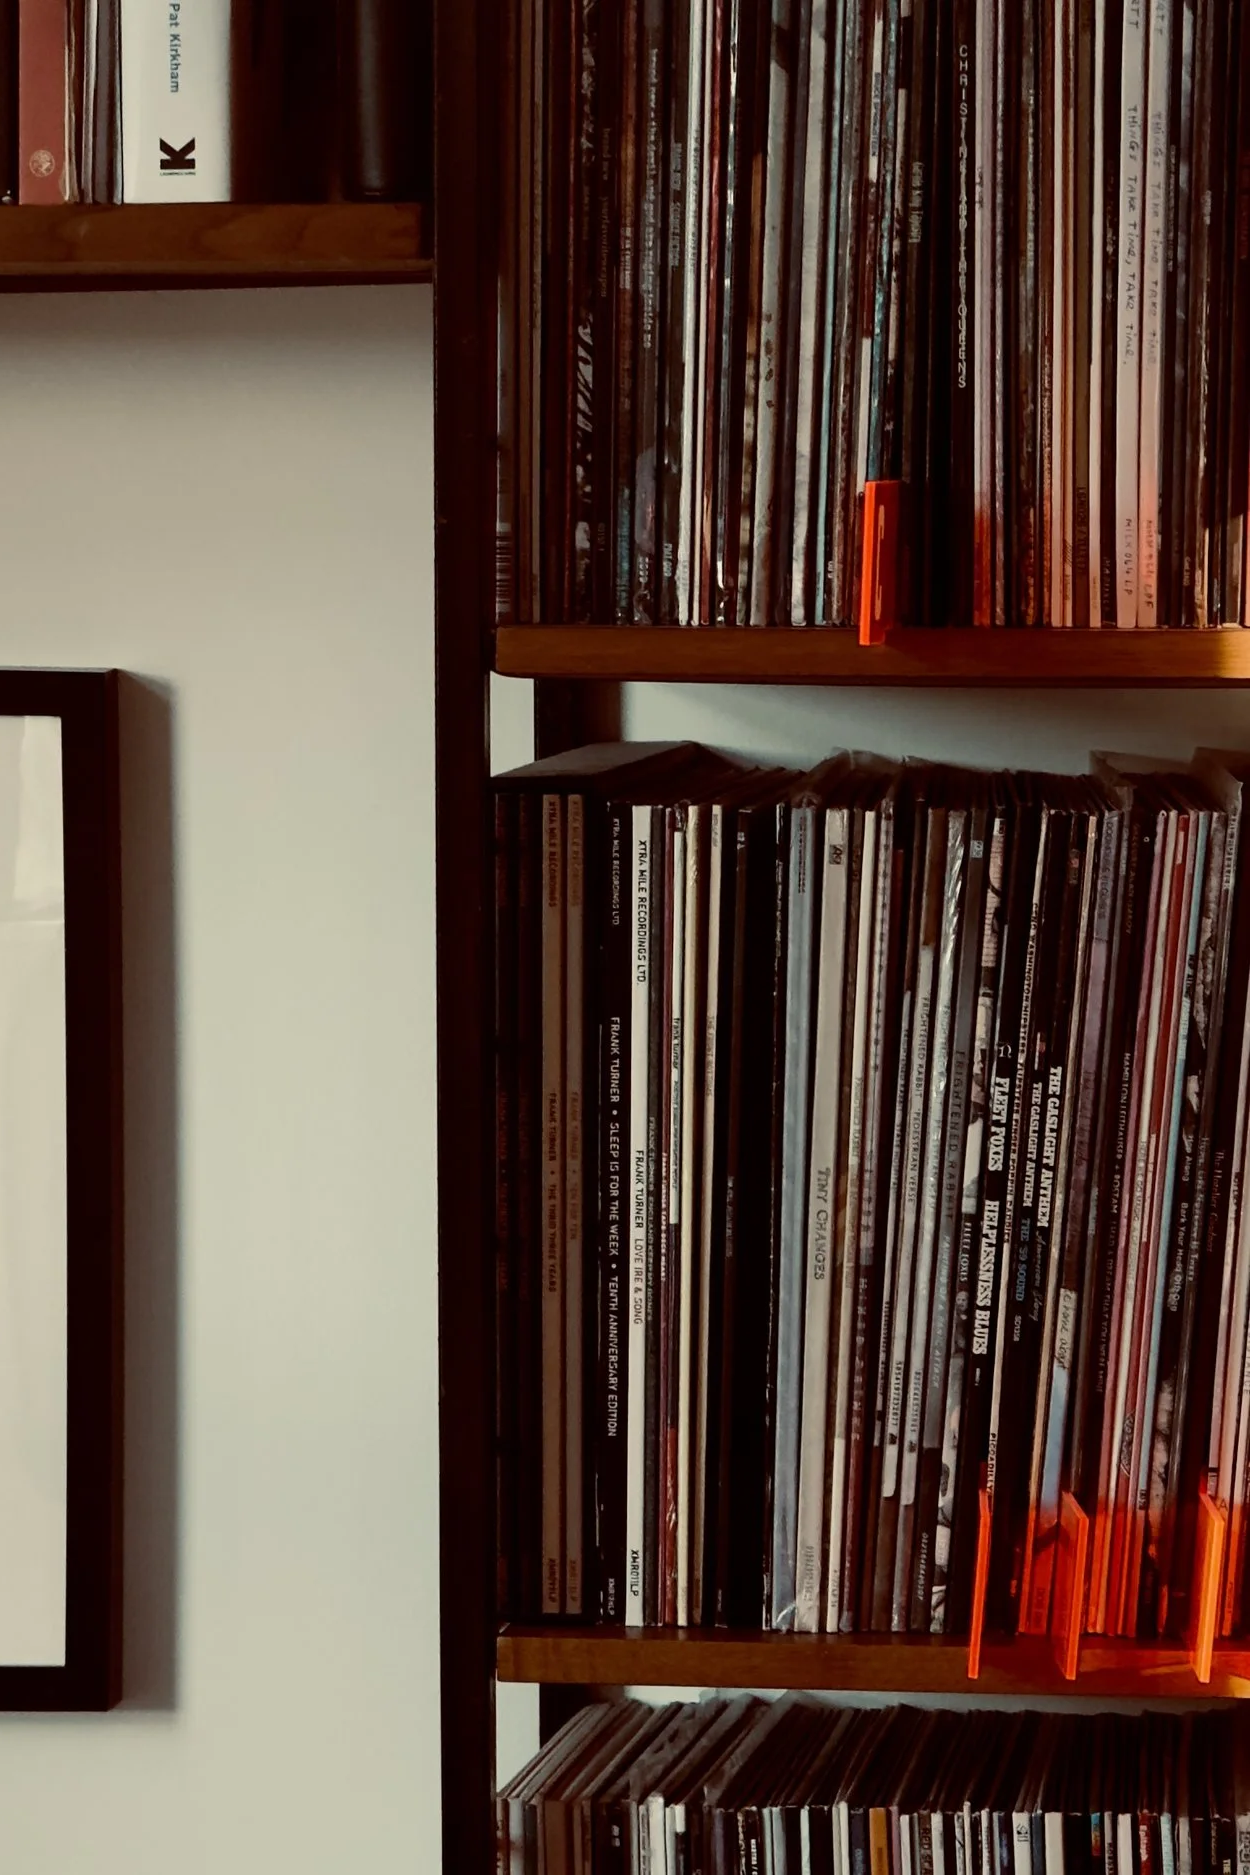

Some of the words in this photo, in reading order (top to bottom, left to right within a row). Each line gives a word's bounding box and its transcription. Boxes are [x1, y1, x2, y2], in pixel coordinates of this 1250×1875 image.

[168, 2, 180, 28] Pat
[169, 33, 180, 94] Kirkham
[159, 136, 196, 170] K
[602, 128, 611, 158] brand
[636, 839, 647, 866] XTRA
[548, 851, 557, 907] RECORDINGS
[636, 870, 647, 893] MILE
[636, 897, 647, 961] RECORDINGS
[635, 964, 646, 986] LTD.
[610, 1017, 620, 1054] FRANK
[672, 1017, 680, 1040] frank
[917, 997, 929, 1060] FRIGHTENED
[610, 1059, 620, 1102] TURNER
[915, 1064, 924, 1098] RABBIT
[1032, 1082, 1042, 1104] THE
[1048, 1066, 1062, 1094] THE
[1121, 1053, 1131, 1103] HAMILTON
[949, 1050, 964, 1152] FRIGHTENED
[992, 1077, 1009, 1123] FLEET
[548, 1126, 557, 1161] TURNER
[609, 1122, 619, 1158] SLEEP
[988, 1126, 1006, 1172] FOXES
[1026, 1106, 1041, 1159] GASLIGHT
[1042, 1097, 1060, 1166] GASLIGHT
[609, 1161, 619, 1172] IS
[634, 1150, 644, 1184] FRANK
[1022, 1161, 1035, 1207] ANTHEM
[609, 1175, 619, 1197] FOR
[817, 1168, 830, 1203] TINY
[945, 1160, 958, 1222] RABBIT
[1036, 1168, 1054, 1227] ANTHEM
[1111, 1174, 1121, 1214] ROSTAM
[609, 1200, 619, 1221] THE
[634, 1189, 644, 1228] TURNER
[1180, 1202, 1188, 1223] Bark
[609, 1224, 619, 1257] WEEK
[813, 1210, 829, 1281] CHANGES
[1021, 1218, 1030, 1242] THE
[1177, 1226, 1186, 1246] Your
[634, 1238, 643, 1263] LOVE
[976, 1200, 999, 1306] HELPLESSNESS
[1034, 1231, 1046, 1287] American
[608, 1276, 619, 1311] TENTH
[634, 1267, 643, 1284] IRE
[1015, 1264, 1027, 1301] SOUND
[633, 1297, 642, 1325] SONG
[1029, 1291, 1043, 1321] Slang
[972, 1309, 990, 1355] BLUES
[608, 1314, 618, 1391] ANNIVERSARY
[608, 1394, 618, 1437] EDITION
[1138, 1825, 1149, 1861] Epitaph
